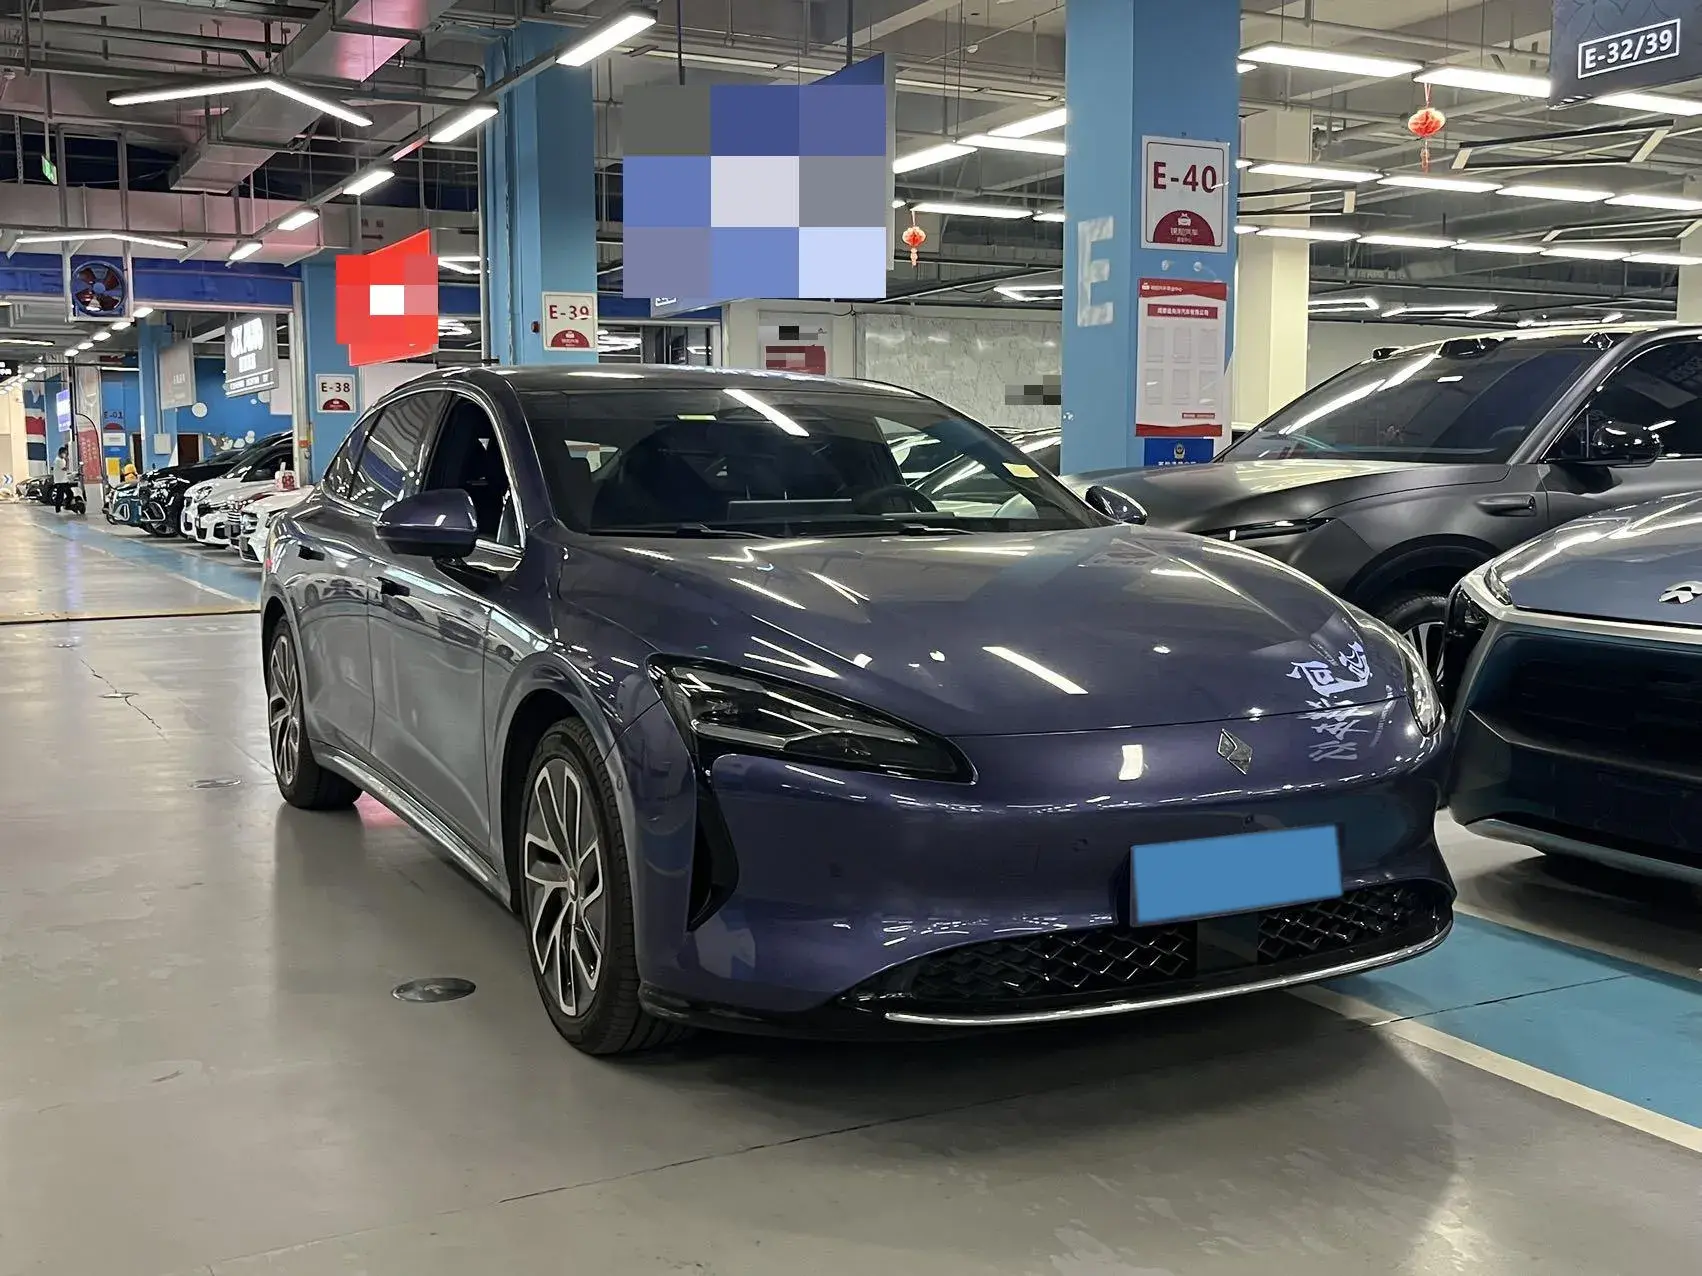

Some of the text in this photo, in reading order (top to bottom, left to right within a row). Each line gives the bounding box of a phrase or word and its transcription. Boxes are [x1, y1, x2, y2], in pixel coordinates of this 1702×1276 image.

[1584, 29, 1673, 69] E-32/39
[1153, 161, 1217, 193] E-40
[1077, 216, 1114, 327] E
[549, 304, 590, 321] E-39
[320, 382, 351, 393] E-38
